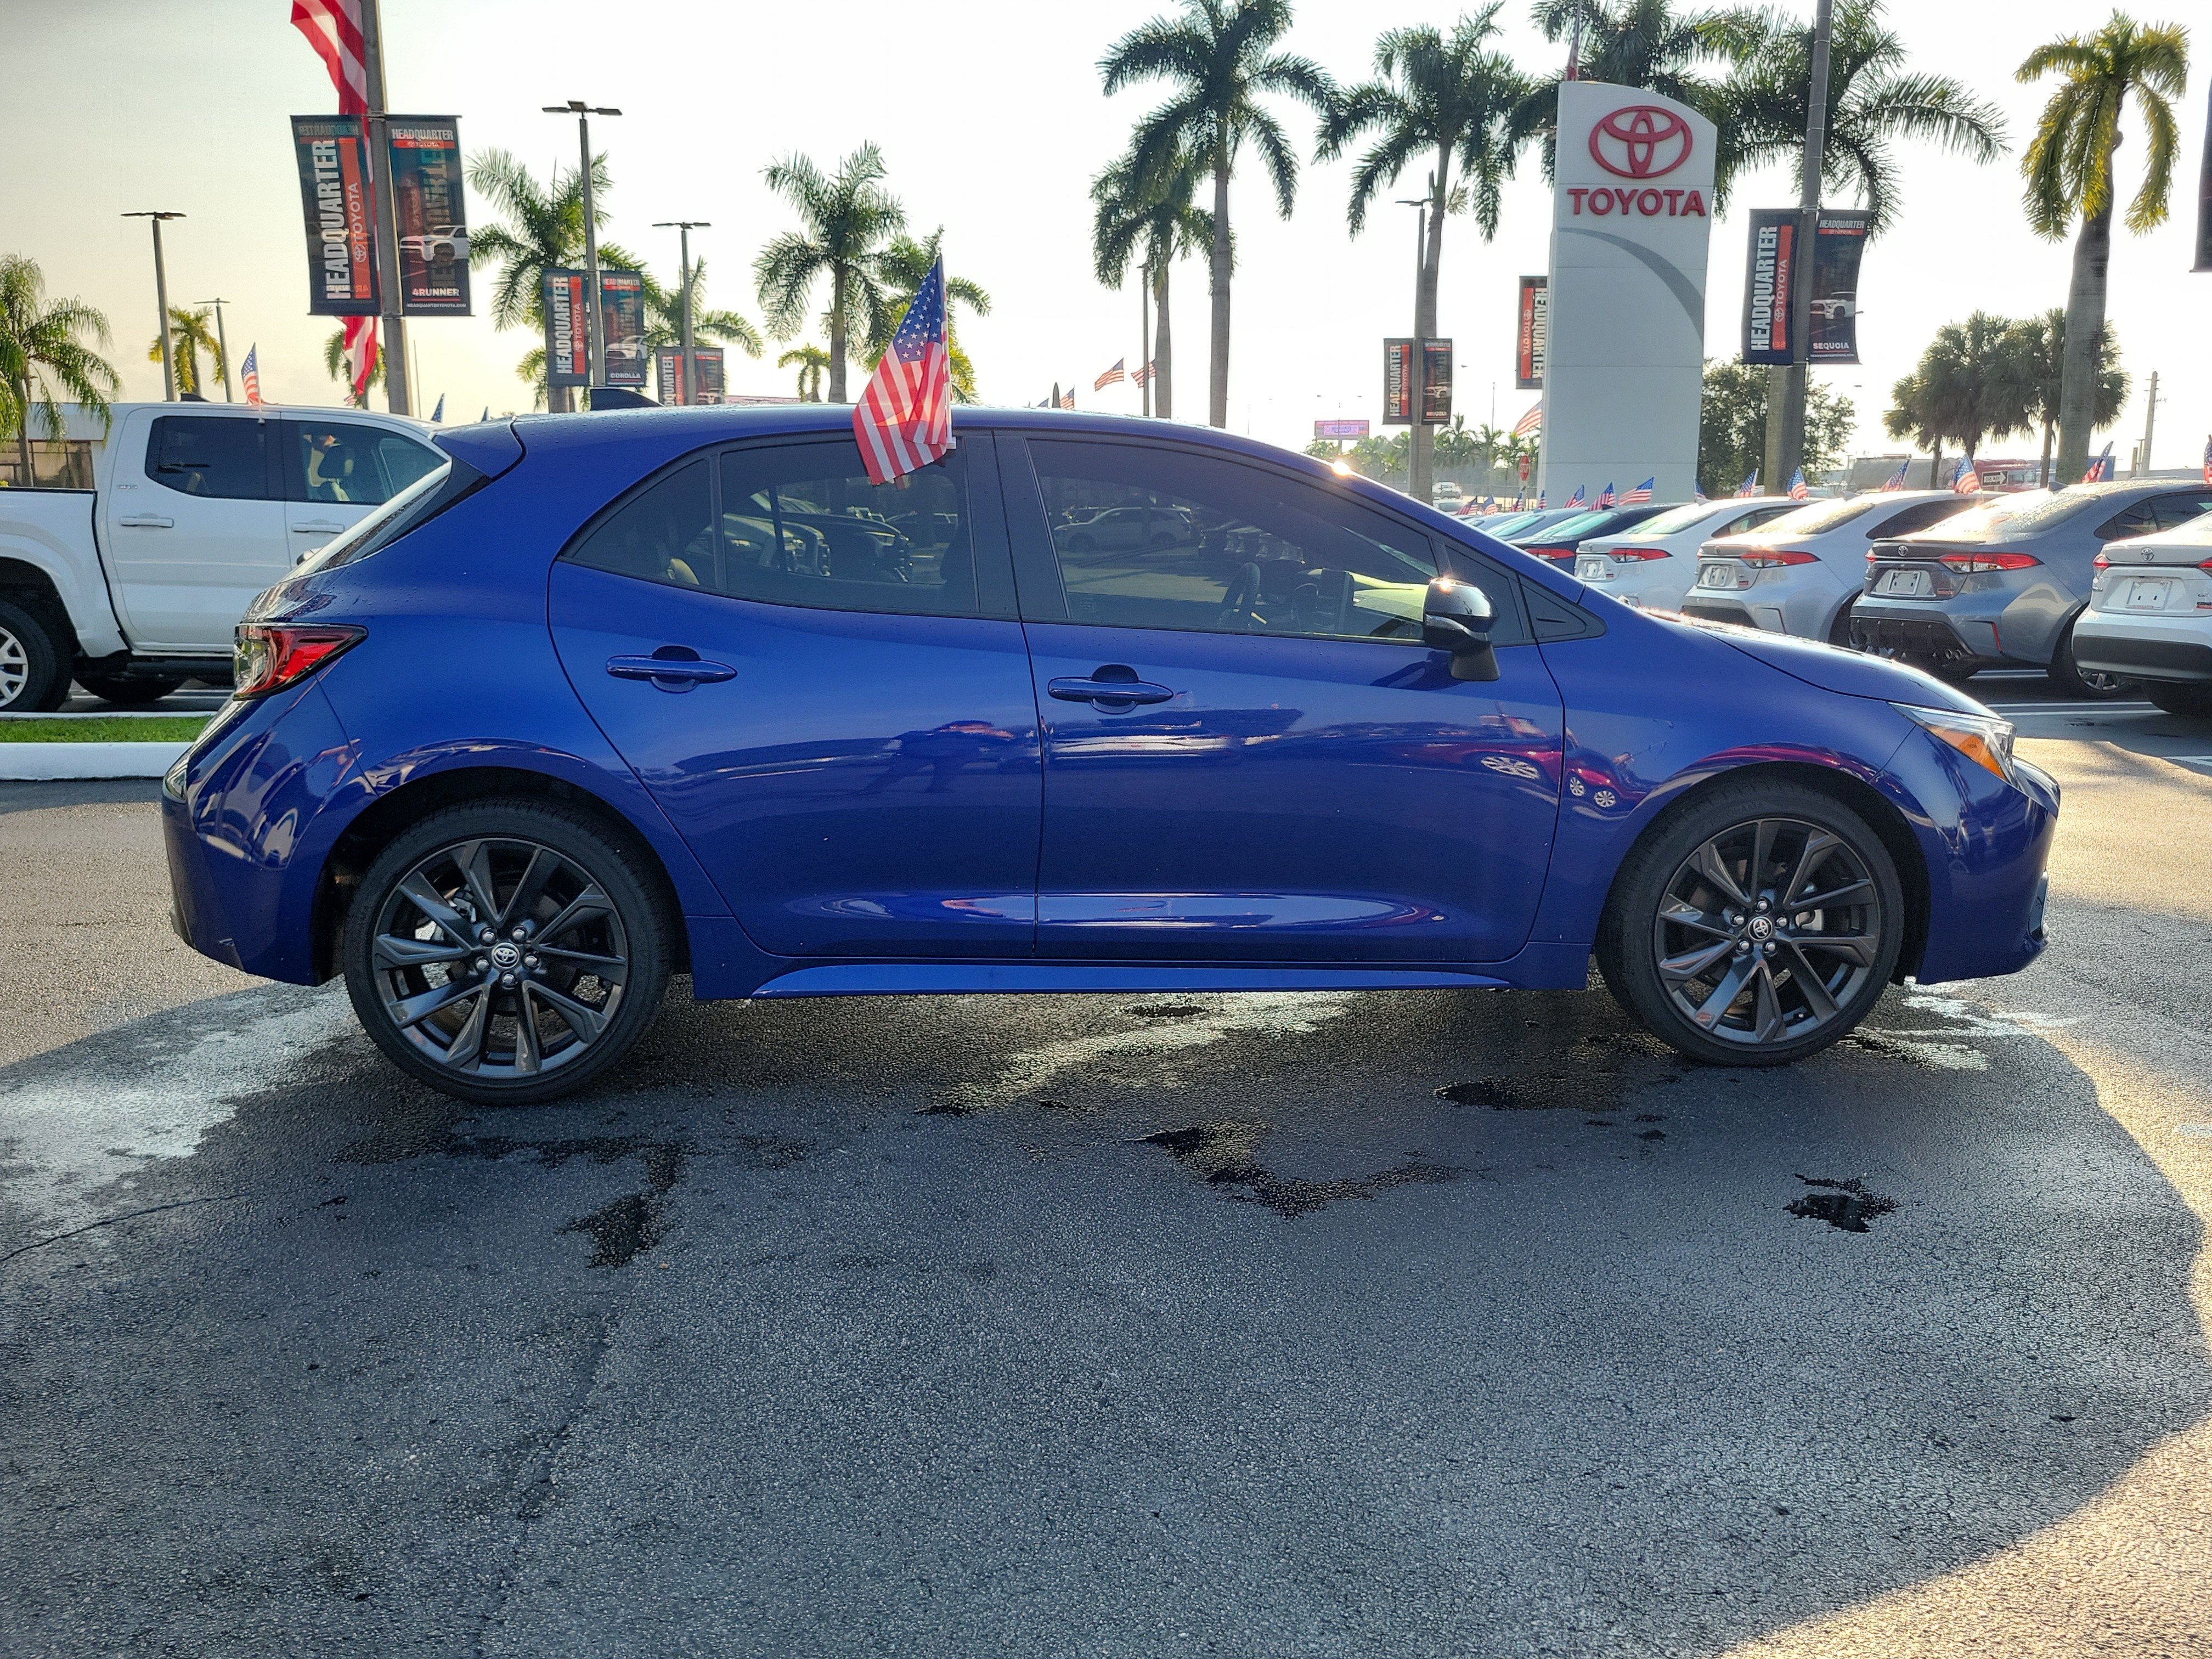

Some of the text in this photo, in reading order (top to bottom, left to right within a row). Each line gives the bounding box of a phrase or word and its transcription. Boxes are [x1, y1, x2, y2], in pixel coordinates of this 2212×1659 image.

[392, 129, 454, 141] HEADQUARTER
[312, 139, 351, 300] HEADQUARTER
[348, 182, 364, 242] TOYOTA
[1567, 188, 1706, 216] TOYOTA
[1819, 220, 1865, 229] HEADQUARTER
[412, 288, 460, 296] 4RUNNER
[1751, 226, 1778, 351] HEADQUARTER
[1776, 259, 1787, 306] TOYOTA
[553, 277, 573, 374] HEADQUARTER
[574, 303, 583, 339] TOYOTA
[1532, 287, 1547, 378] HEADQUARTER
[1390, 346, 1402, 416] HEADQUARTER
